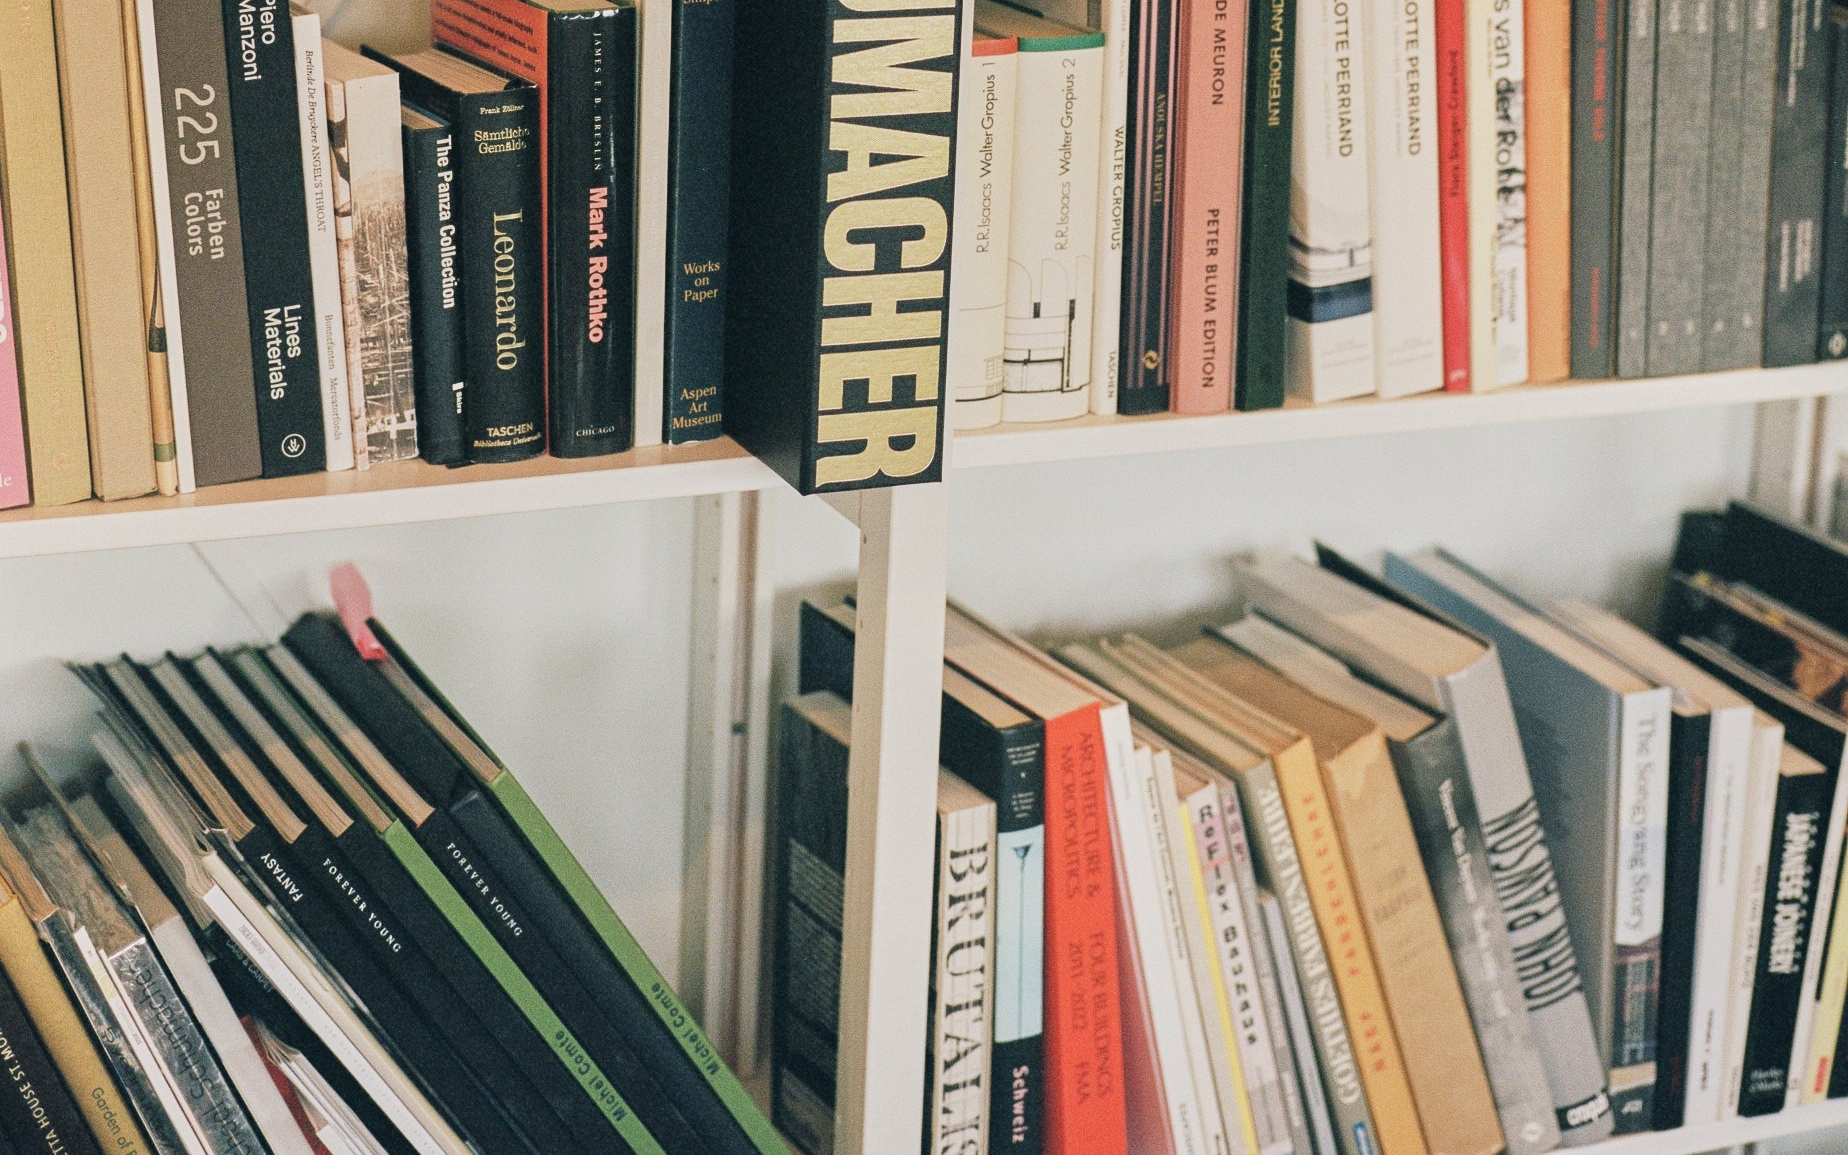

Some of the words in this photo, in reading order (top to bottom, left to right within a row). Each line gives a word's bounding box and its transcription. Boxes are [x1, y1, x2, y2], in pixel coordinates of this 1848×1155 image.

[1214, 0, 1227, 21] DE
[593, 33, 602, 75] JAMES
[1210, 29, 1226, 105] MEURON
[1494, 18, 1511, 69] van
[1266, 46, 1283, 126] INTERIOR
[1335, 57, 1353, 157] PERRIAND
[1405, 56, 1421, 155] PERRIAND
[1495, 77, 1518, 121] der
[175, 83, 221, 165] 225
[594, 116, 602, 171] BRESLIN
[1153, 92, 1168, 150] ANOUSKA
[436, 135, 452, 167] The
[1113, 126, 1125, 182] WALTER
[438, 170, 454, 221] Panza
[1151, 153, 1166, 205] HEMPEL
[184, 192, 203, 256] Colors
[206, 188, 225, 260] Farben
[589, 187, 608, 250] Mark
[1111, 186, 1123, 251] GROPIUS
[1206, 209, 1219, 257] PETER
[439, 224, 457, 309] Collection
[493, 209, 526, 371] Leonardo
[683, 262, 720, 276] Works
[694, 276, 709, 287] on
[1204, 264, 1218, 312] BLUM
[588, 256, 608, 343] Rothko
[684, 288, 719, 302] Paper
[264, 308, 287, 400] Materials
[284, 304, 301, 358] Lines
[324, 314, 335, 369] Bonnefanten
[1201, 319, 1216, 388] EDITION
[329, 377, 342, 440] Mercatorfonds
[680, 385, 717, 401] Aspen
[689, 402, 708, 414] Art
[487, 423, 533, 437] TASCHEN
[575, 425, 615, 437] CHICAGO
[672, 412, 722, 430] Museum
[1635, 715, 1657, 756] The
[1628, 760, 1655, 875] Songyang
[260, 853, 303, 902] FANTASY
[446, 842, 490, 896] FOREVER
[490, 896, 523, 937] YOUNG
[1484, 798, 1567, 931] PAWSON
[323, 858, 367, 913] FOREVER
[368, 912, 401, 954] YOUNG
[1624, 875, 1652, 935] Story
[1514, 925, 1583, 1012] JOHN
[651, 982, 685, 1029] Comte
[555, 1030, 589, 1075] Comte
[684, 1029, 720, 1075] Michel
[1311, 980, 1362, 1105] GOETHES
[92, 1087, 121, 1135] Garden
[117, 1137, 133, 1149] of
[589, 1076, 628, 1122] Michel
[1012, 1065, 1029, 1143] Schweiz
